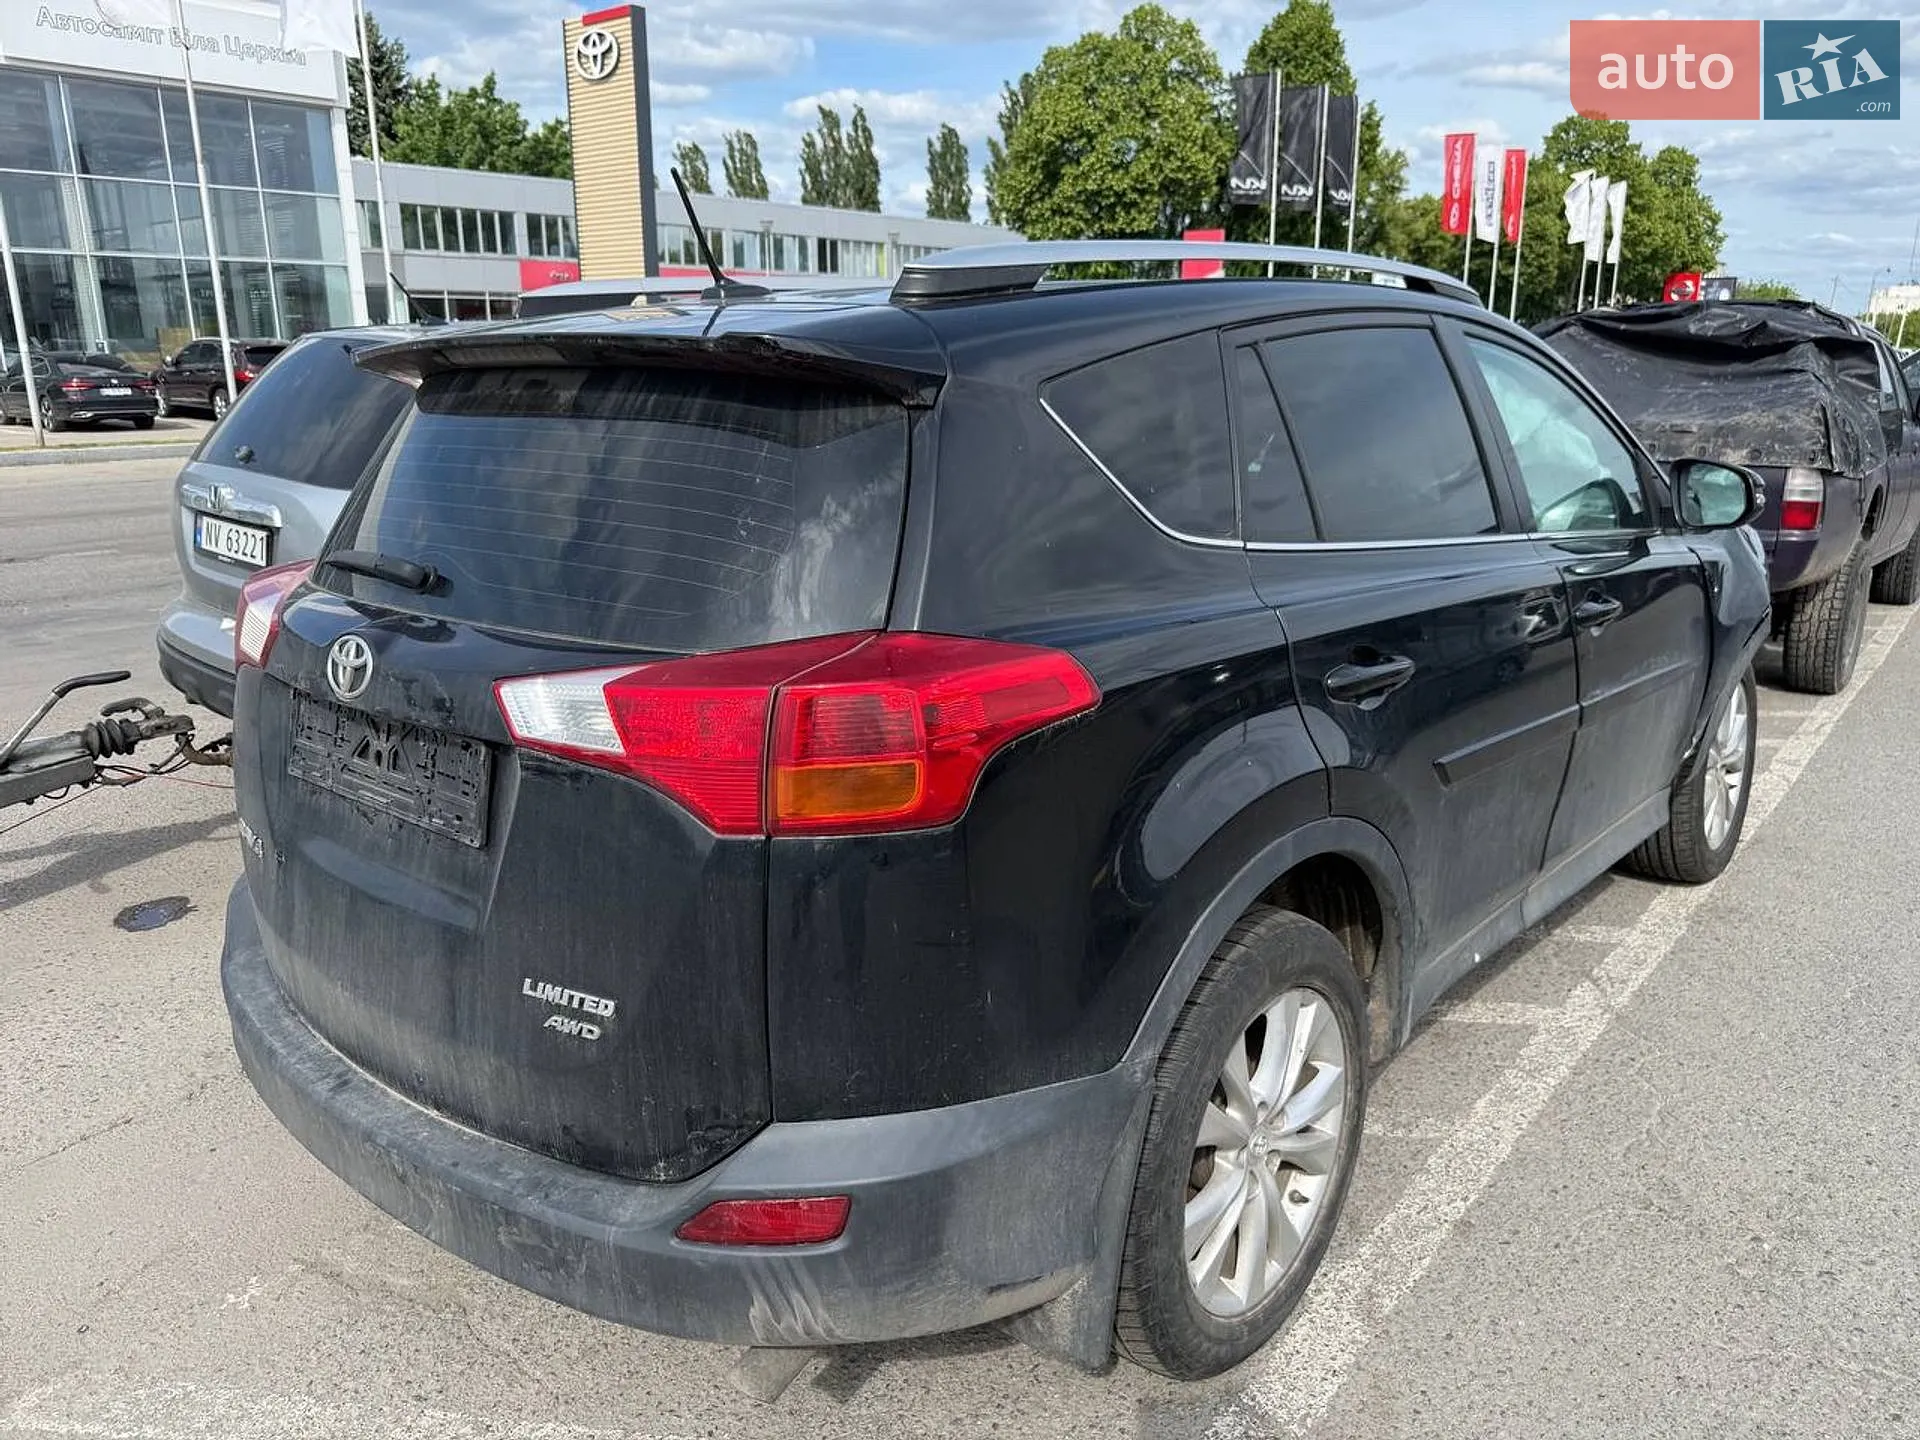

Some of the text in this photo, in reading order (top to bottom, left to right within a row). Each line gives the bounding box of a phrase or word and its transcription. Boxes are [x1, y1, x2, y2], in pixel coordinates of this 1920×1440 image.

[205, 520, 265, 562] NV 63221
[522, 978, 616, 1018] LIMITED
[543, 1015, 601, 1040] AWD
